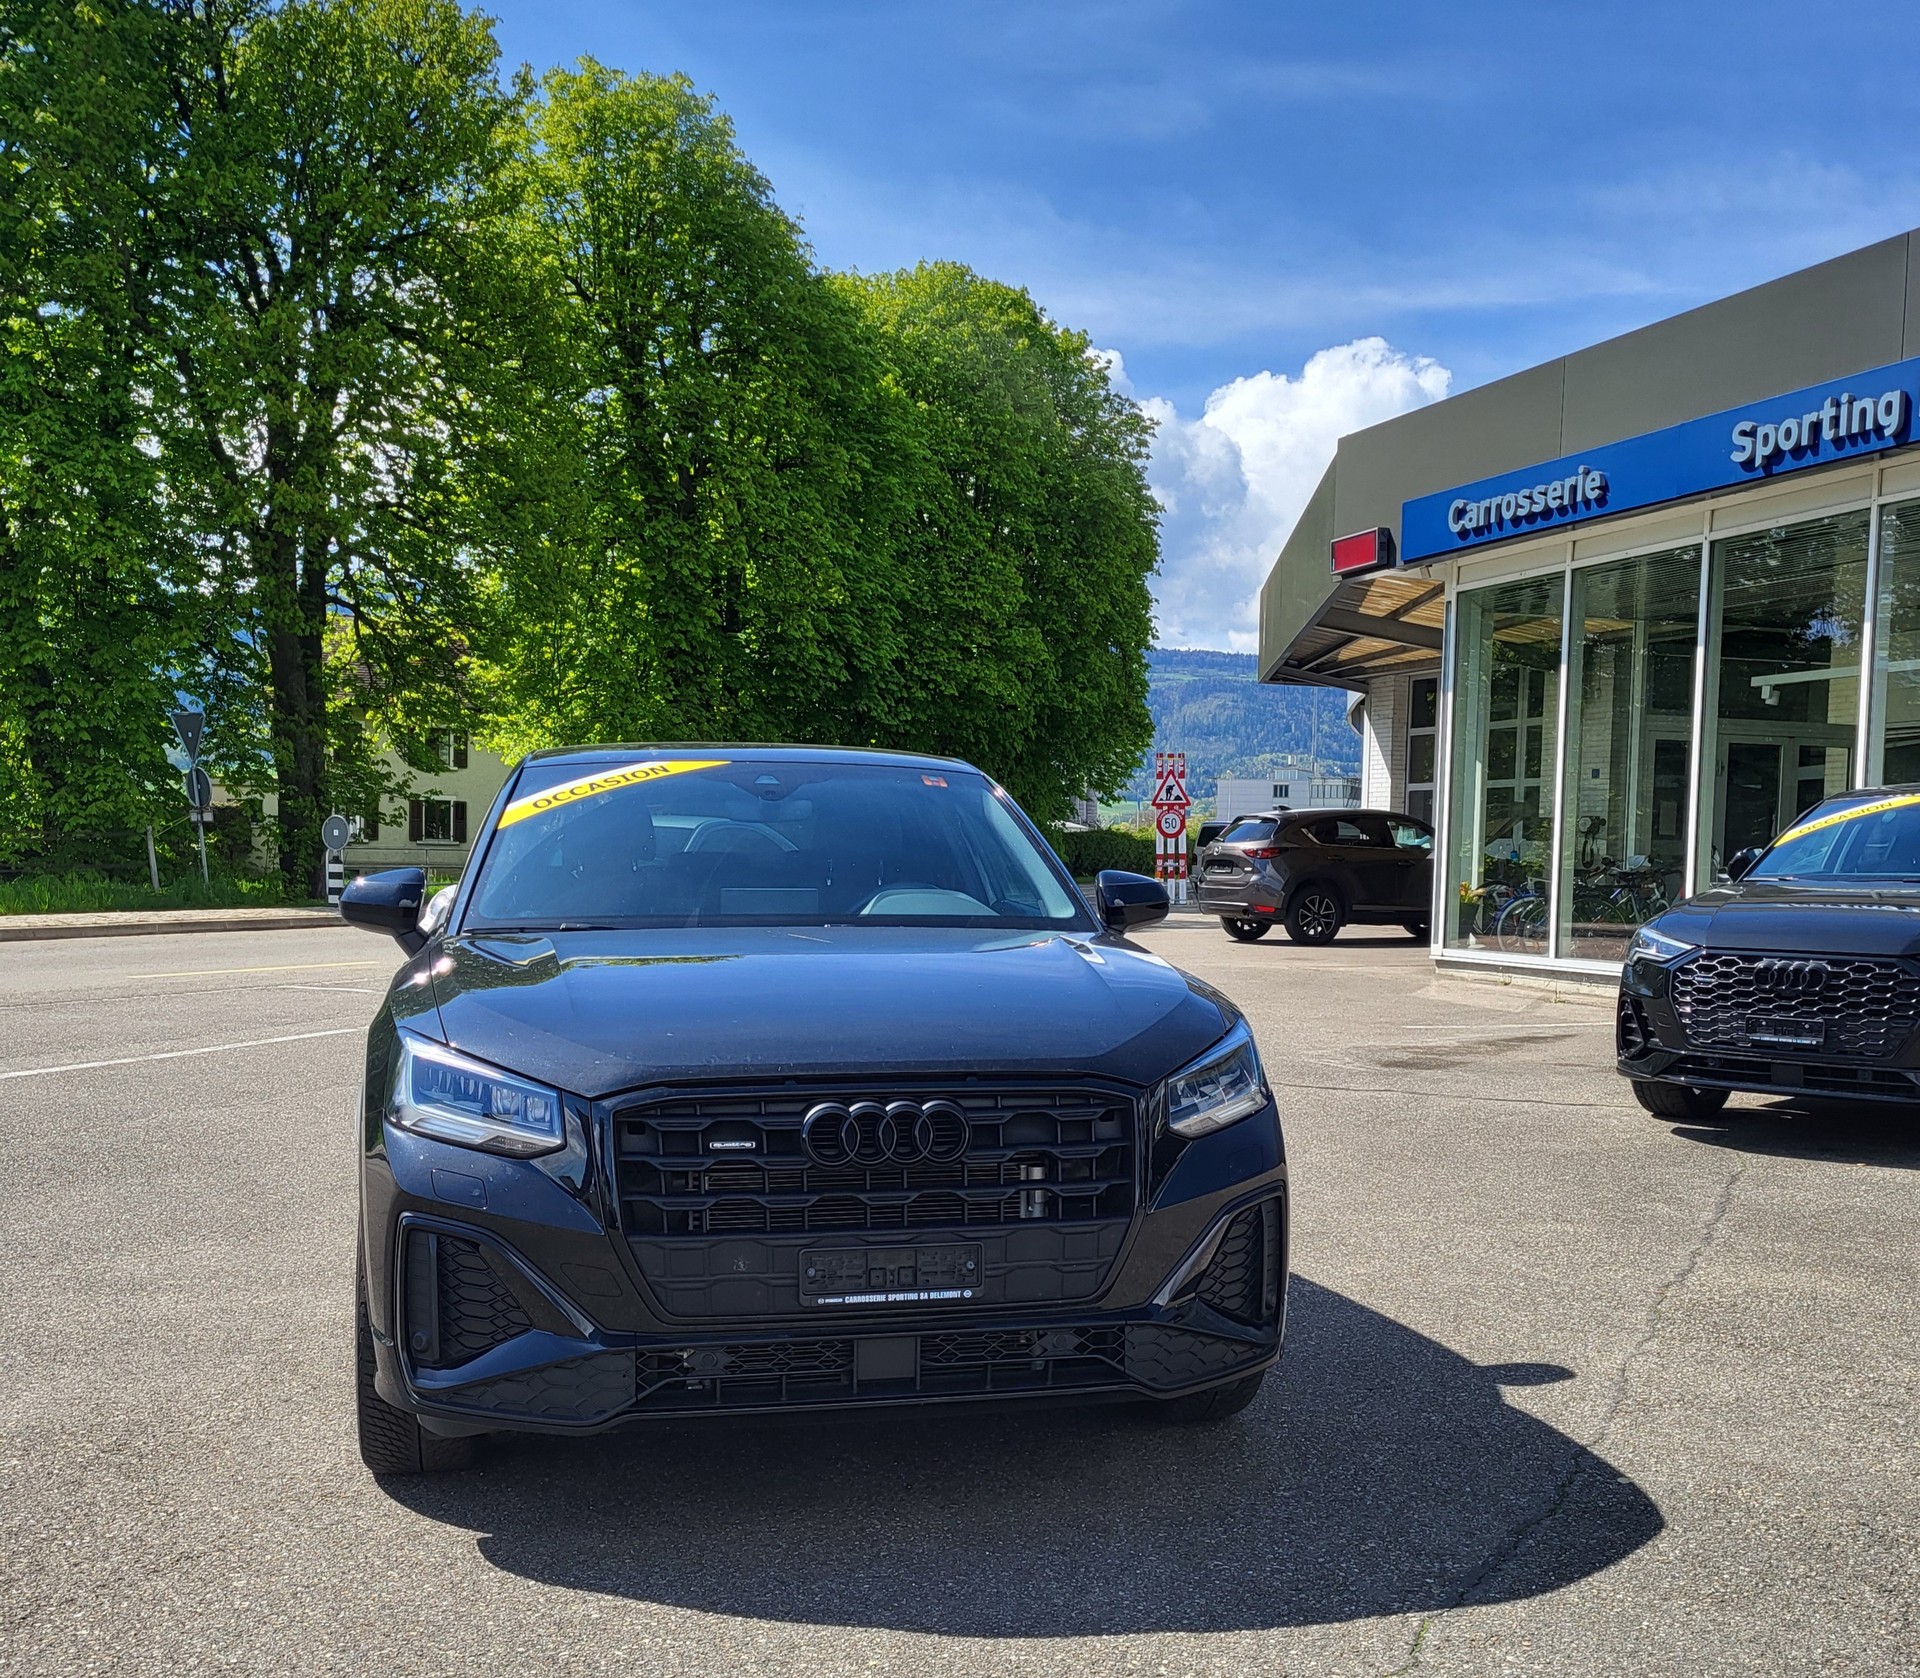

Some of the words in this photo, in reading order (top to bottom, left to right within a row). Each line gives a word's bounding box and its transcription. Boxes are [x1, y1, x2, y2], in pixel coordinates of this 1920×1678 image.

[1448, 465, 1604, 534] Carrosserie
[1730, 388, 1902, 468] Sporting
[532, 765, 672, 809] OCCASION
[1164, 817, 1177, 829] 50
[1798, 802, 1893, 834] OCCASION
[845, 1294, 886, 1303] CARROSSERIE
[888, 1292, 918, 1301] SPORTING
[920, 1292, 929, 1300] SA
